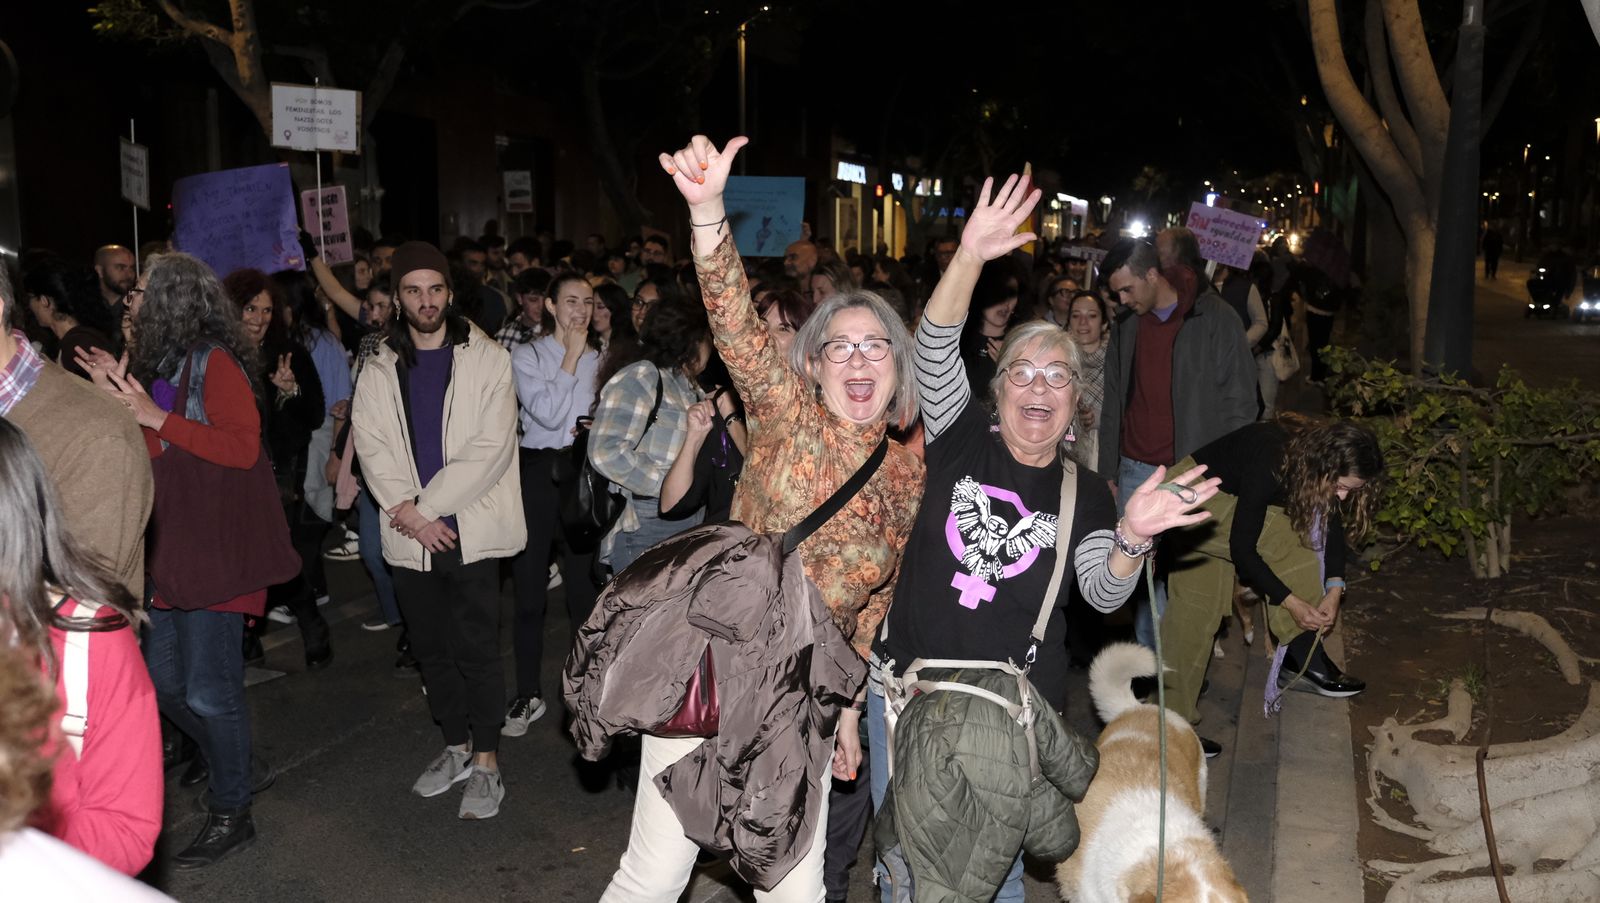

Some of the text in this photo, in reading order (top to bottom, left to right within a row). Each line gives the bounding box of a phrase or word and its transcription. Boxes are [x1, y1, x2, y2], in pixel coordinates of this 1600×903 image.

[1188, 213, 1257, 233] SIN derechos
[1210, 227, 1254, 244] igualdad
